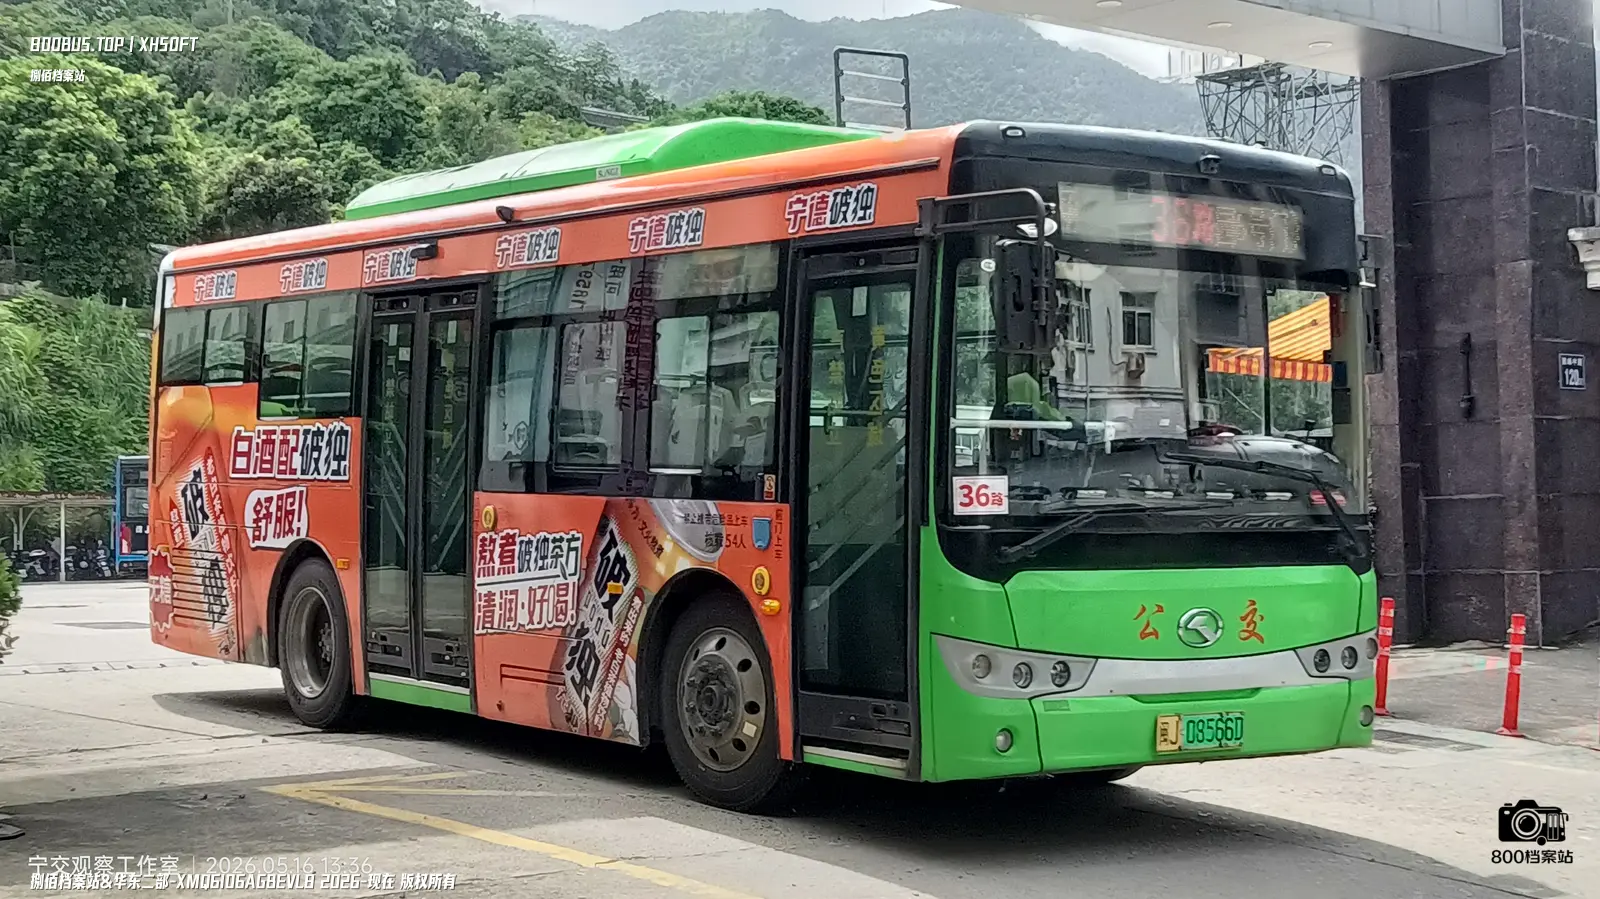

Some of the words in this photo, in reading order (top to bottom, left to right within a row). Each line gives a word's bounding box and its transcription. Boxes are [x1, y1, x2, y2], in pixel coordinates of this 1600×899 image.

[786, 184, 877, 231] 宁德破独
[496, 228, 560, 266] 宁德破独
[629, 209, 705, 251] 宁德破独
[194, 271, 236, 300] 宁德破独
[280, 258, 328, 292] 宁德破独
[363, 249, 416, 283] 宁德破独
[232, 424, 349, 478] 白酒配破独
[958, 484, 1004, 507] 36路
[477, 530, 581, 578] 熬煮破独茶方
[1133, 604, 1165, 641] 公
[1238, 599, 1265, 645] 交
